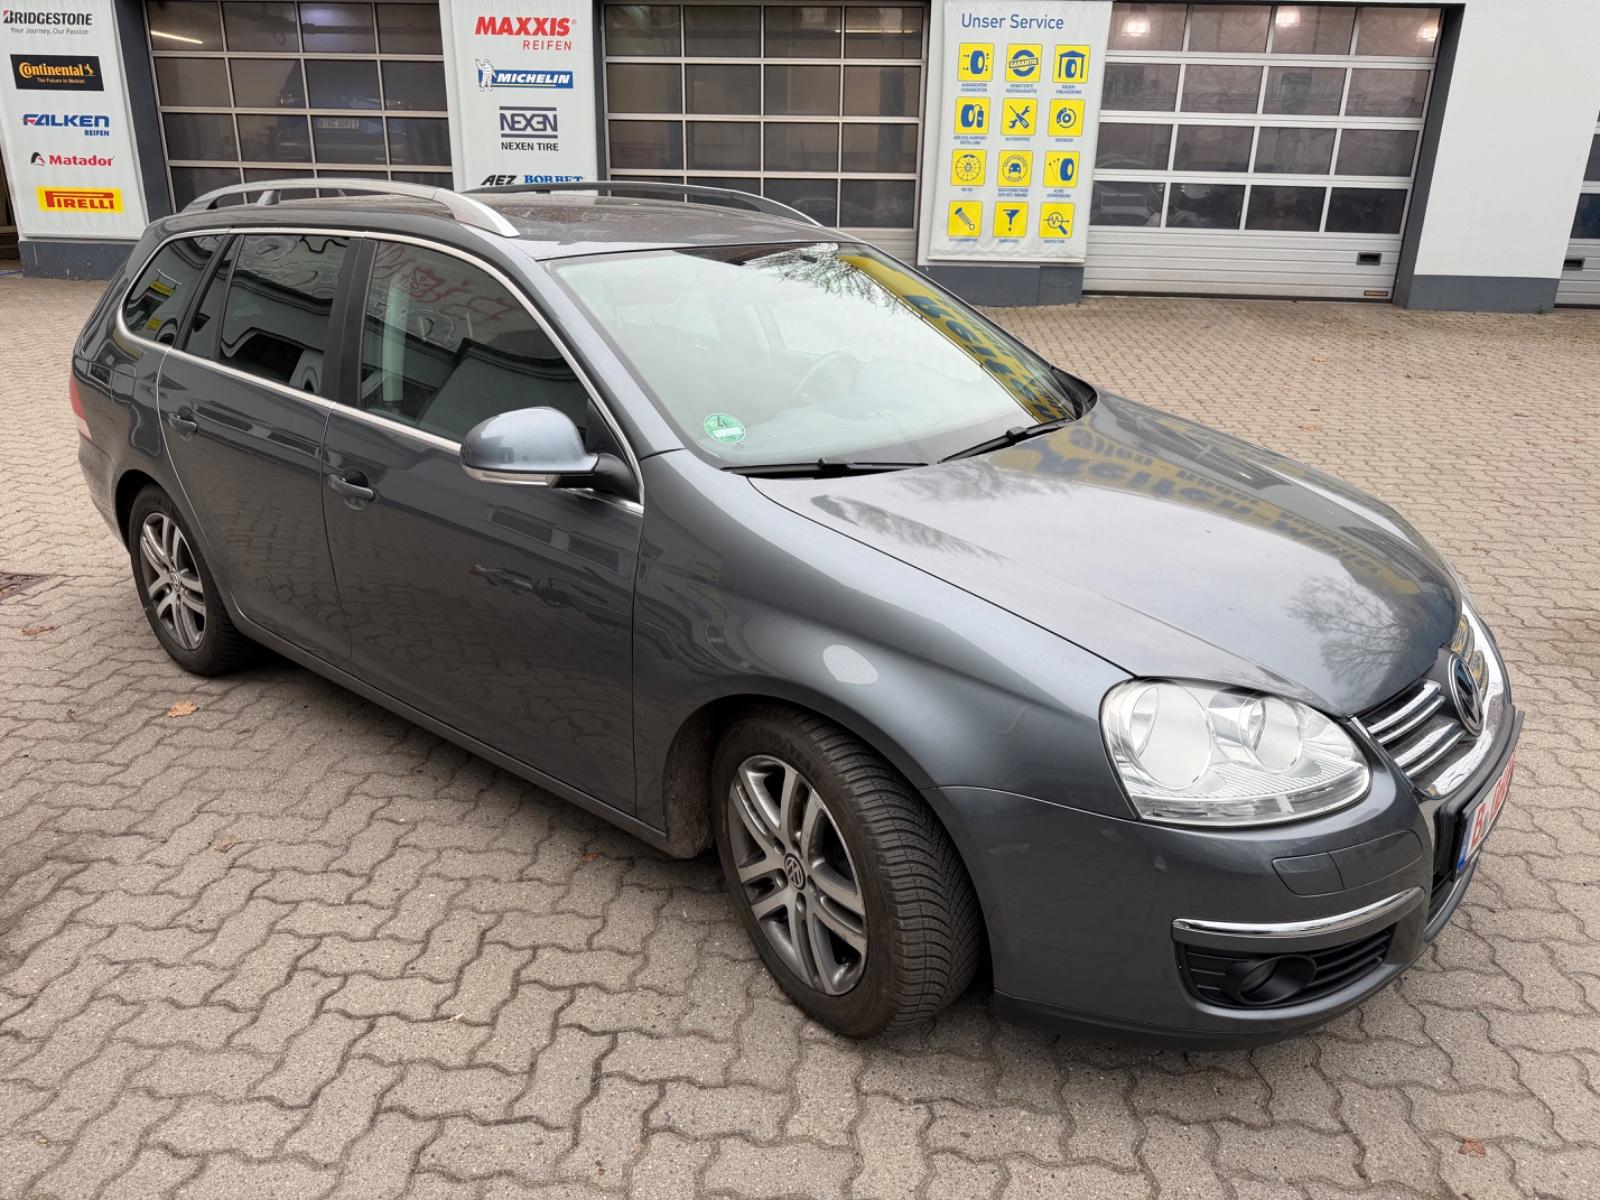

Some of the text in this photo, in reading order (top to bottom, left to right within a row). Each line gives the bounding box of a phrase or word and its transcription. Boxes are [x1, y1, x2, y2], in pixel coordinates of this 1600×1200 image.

[3, 10, 92, 26] BRIDGESTONE
[961, 13, 1064, 30] Unser Service
[475, 16, 570, 36] MAXXIS
[522, 40, 572, 51] REIFEN
[18, 62, 84, 79] Continental
[497, 73, 570, 84] MICHELIN
[23, 114, 110, 128] FALKEN
[500, 113, 558, 132] NEXEN
[84, 129, 110, 137] REIFEN
[501, 142, 559, 151] NEXEN TIRE
[49, 155, 114, 167] Matador
[480, 175, 518, 186] AEZ
[45, 191, 114, 209] PIRELLI
